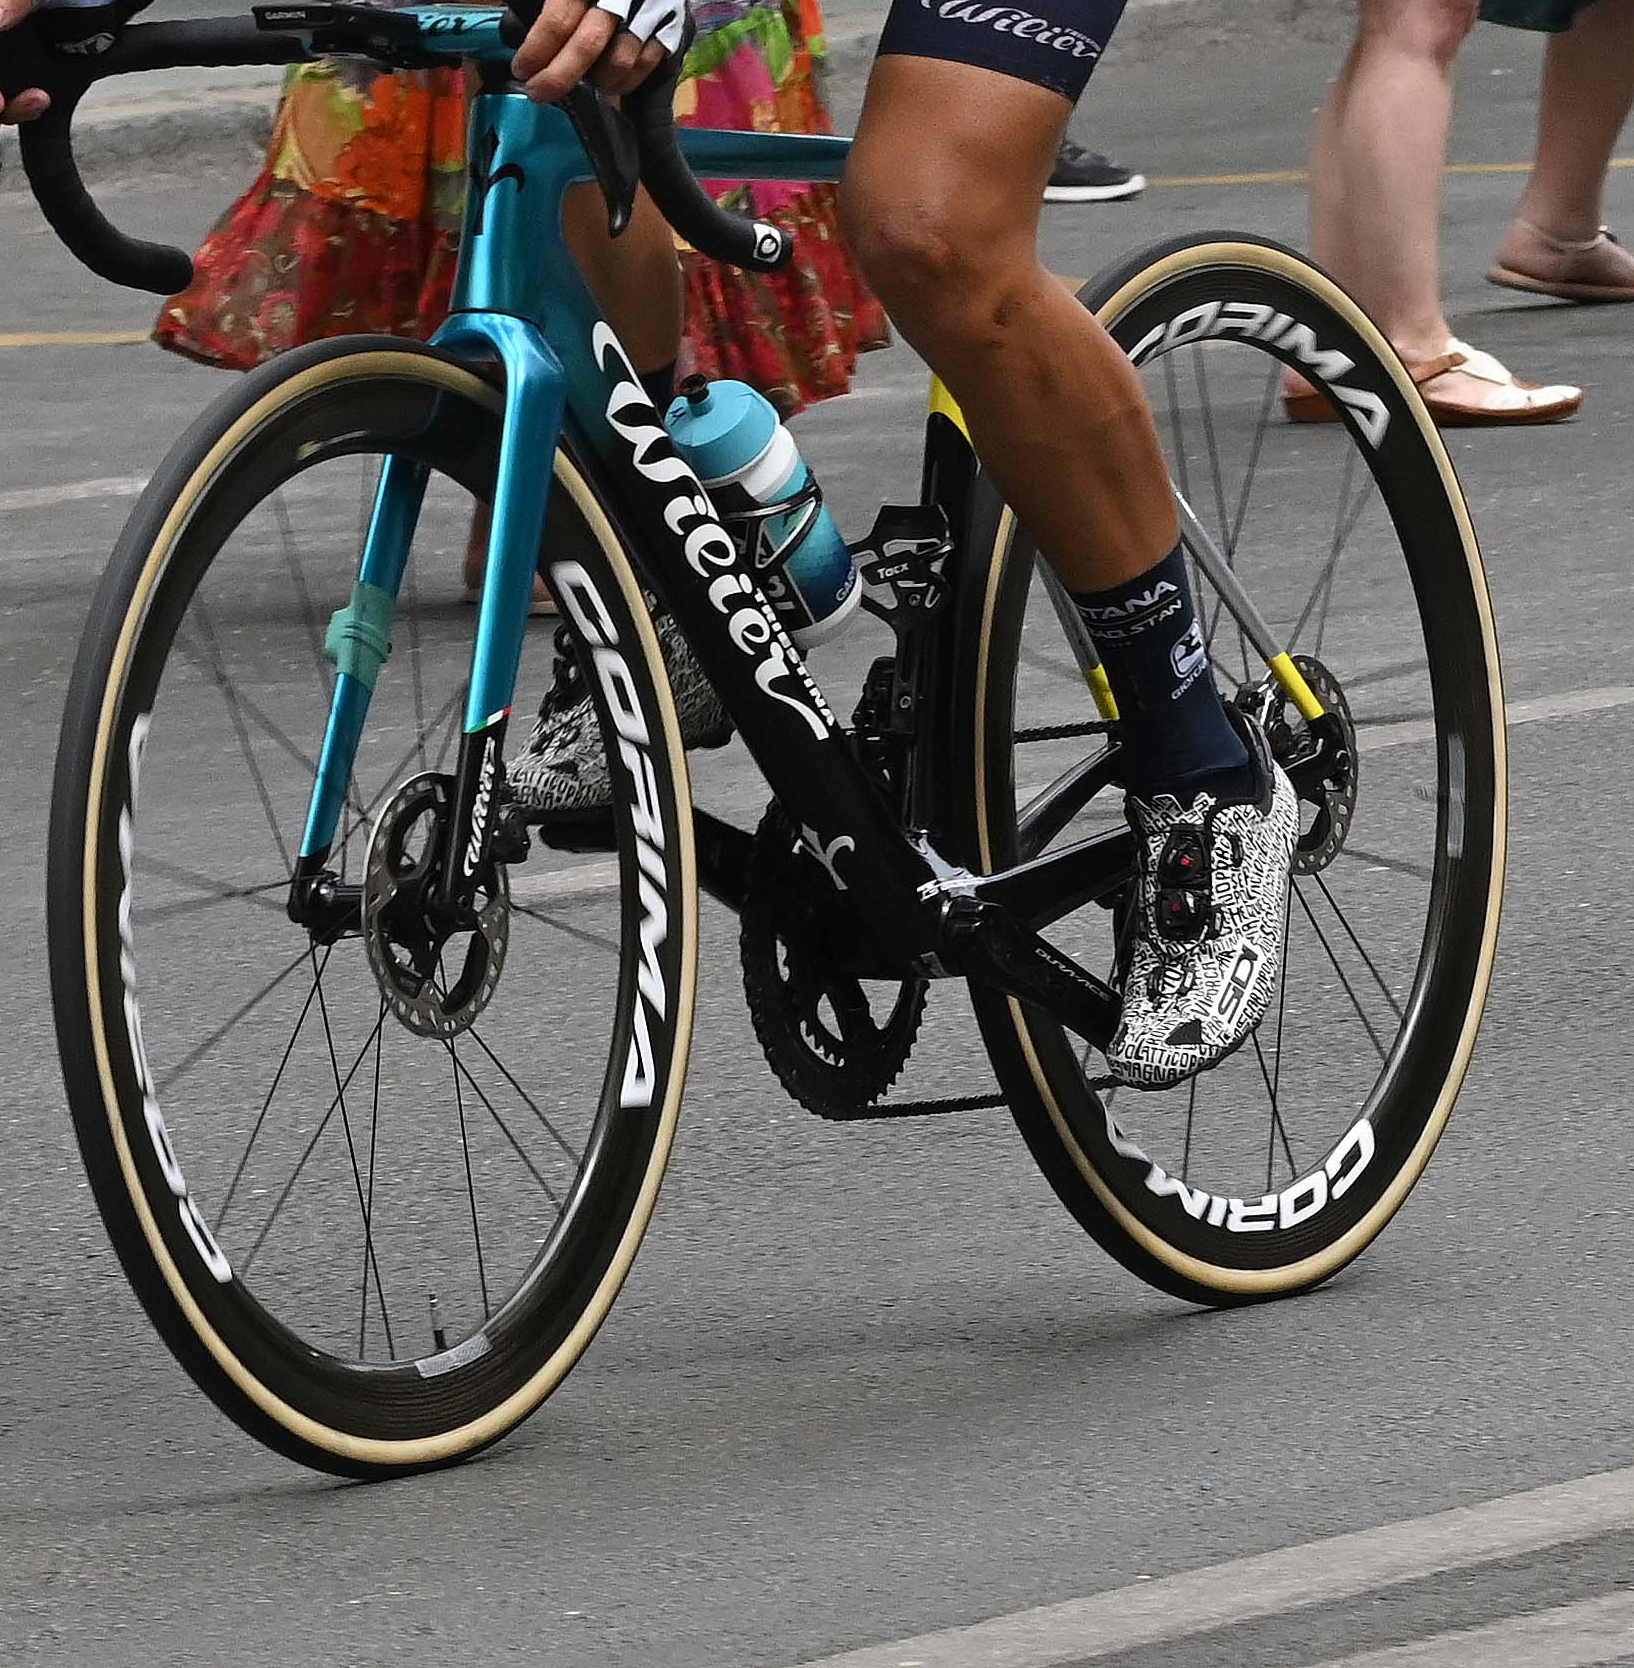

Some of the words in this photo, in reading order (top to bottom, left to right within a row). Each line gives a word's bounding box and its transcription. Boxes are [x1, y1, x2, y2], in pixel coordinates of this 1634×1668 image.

[1127, 300, 1392, 451] CORIMA
[592, 321, 830, 741] Wilier
[877, 561, 910, 580] Tacx
[753, 587, 835, 727] TRIESTINA
[547, 559, 667, 1110] CORIMA
